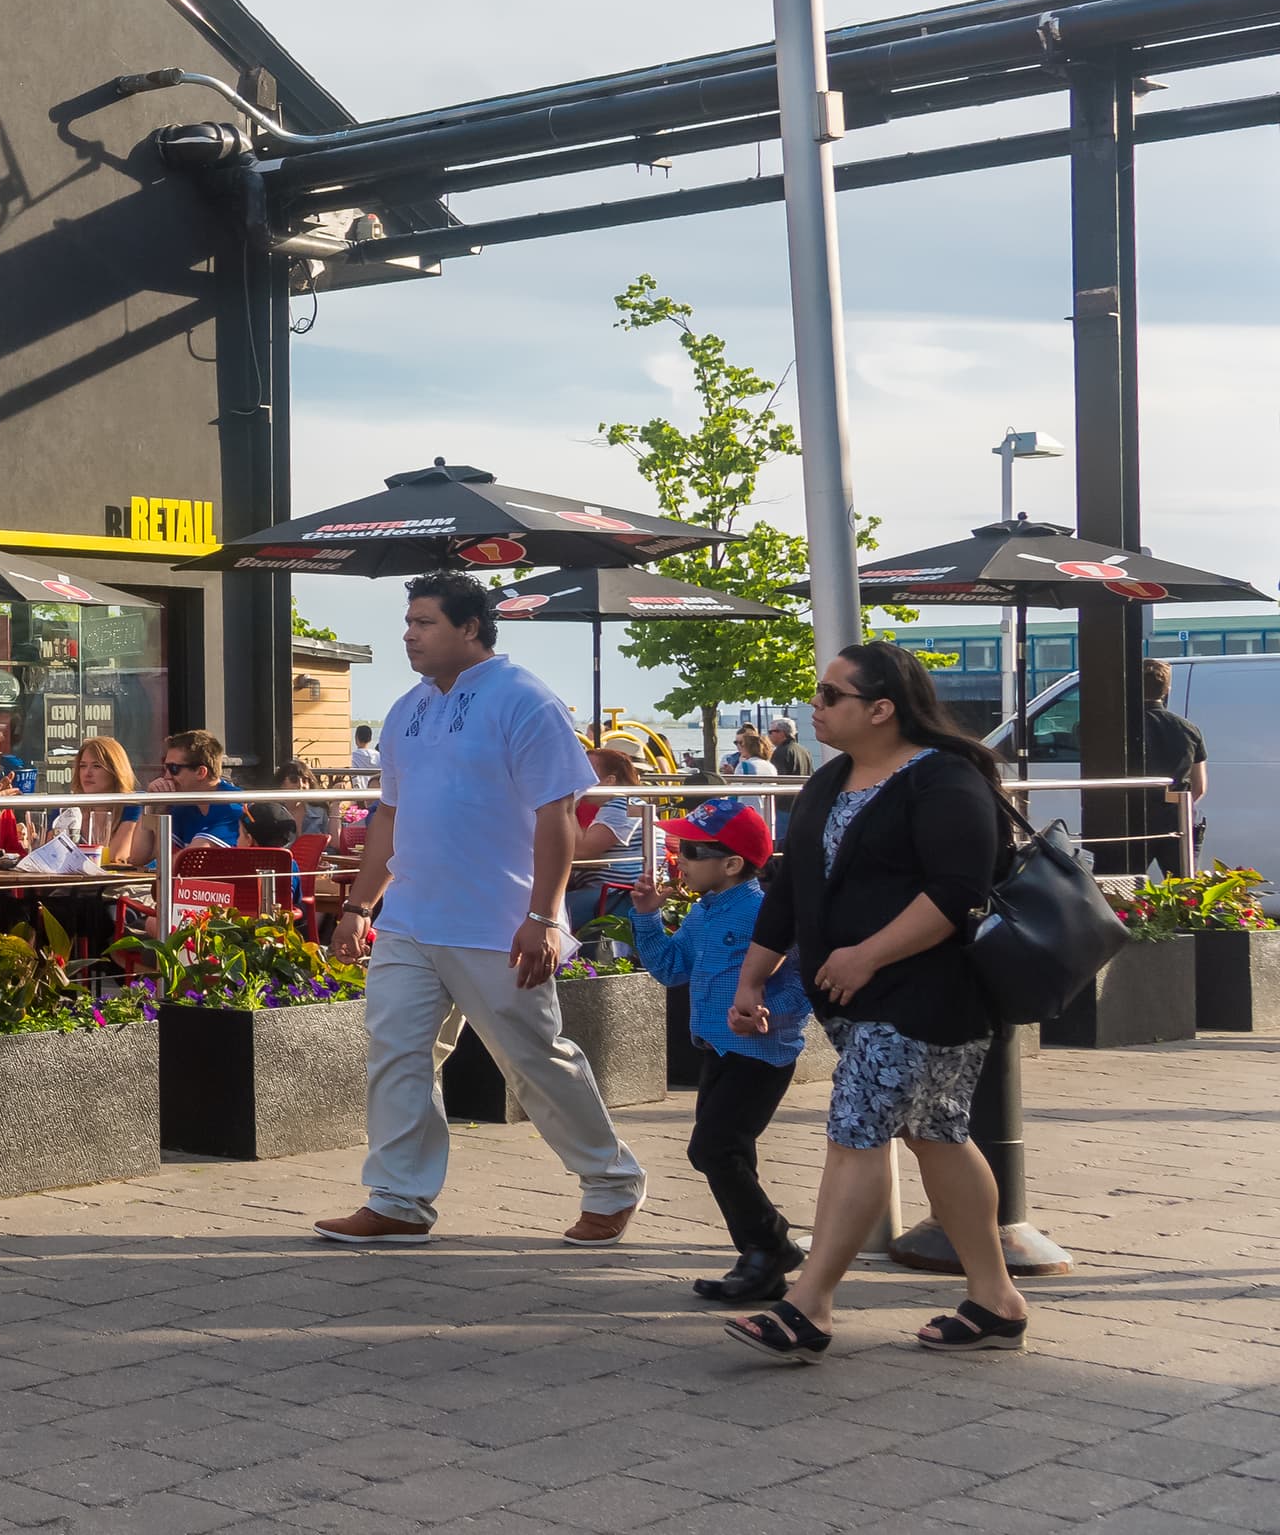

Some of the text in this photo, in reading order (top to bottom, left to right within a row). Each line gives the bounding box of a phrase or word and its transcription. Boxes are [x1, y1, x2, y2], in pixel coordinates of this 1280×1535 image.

[131, 495, 217, 545] RETAIL
[178, 888, 231, 904] NO SMOKING
